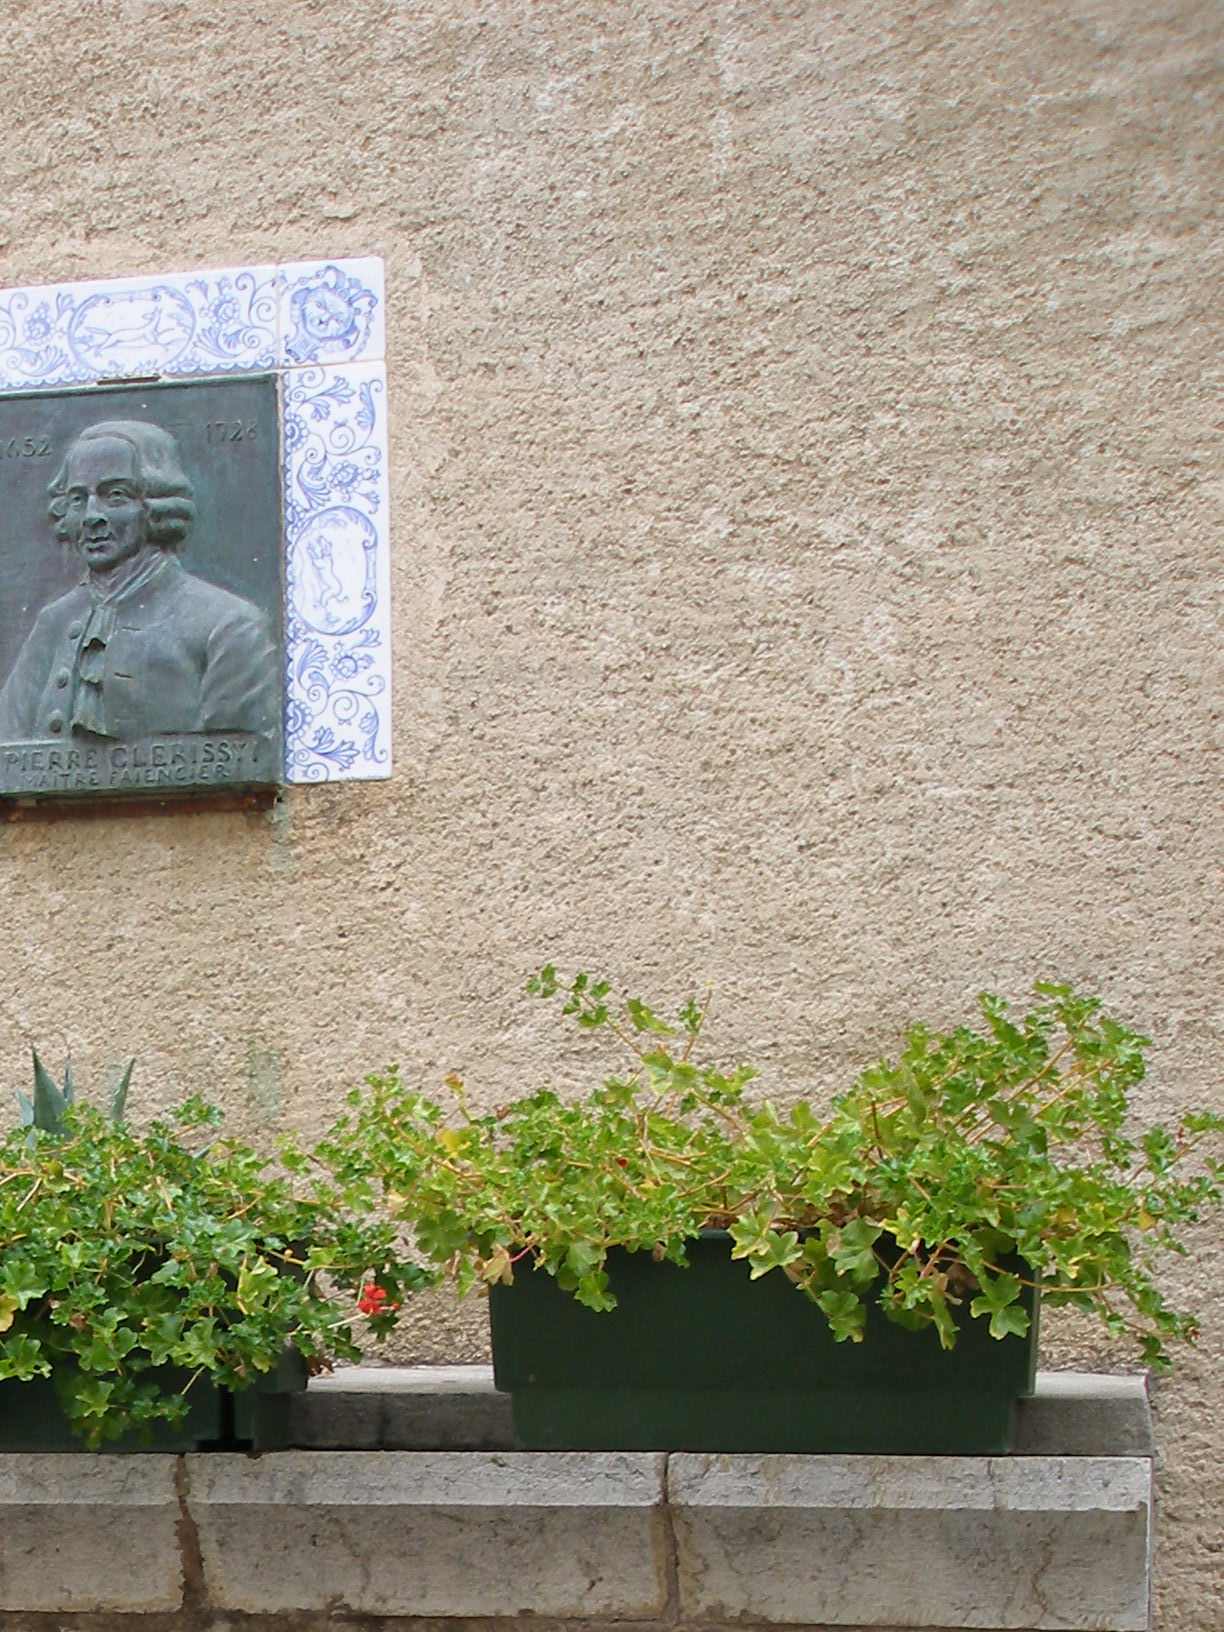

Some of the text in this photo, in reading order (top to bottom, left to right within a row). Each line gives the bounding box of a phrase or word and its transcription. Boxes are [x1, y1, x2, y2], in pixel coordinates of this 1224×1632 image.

[5, 748, 98, 773] PIERRE
[110, 742, 248, 768] CLERISSY
[109, 763, 232, 785] FAIENCIER
